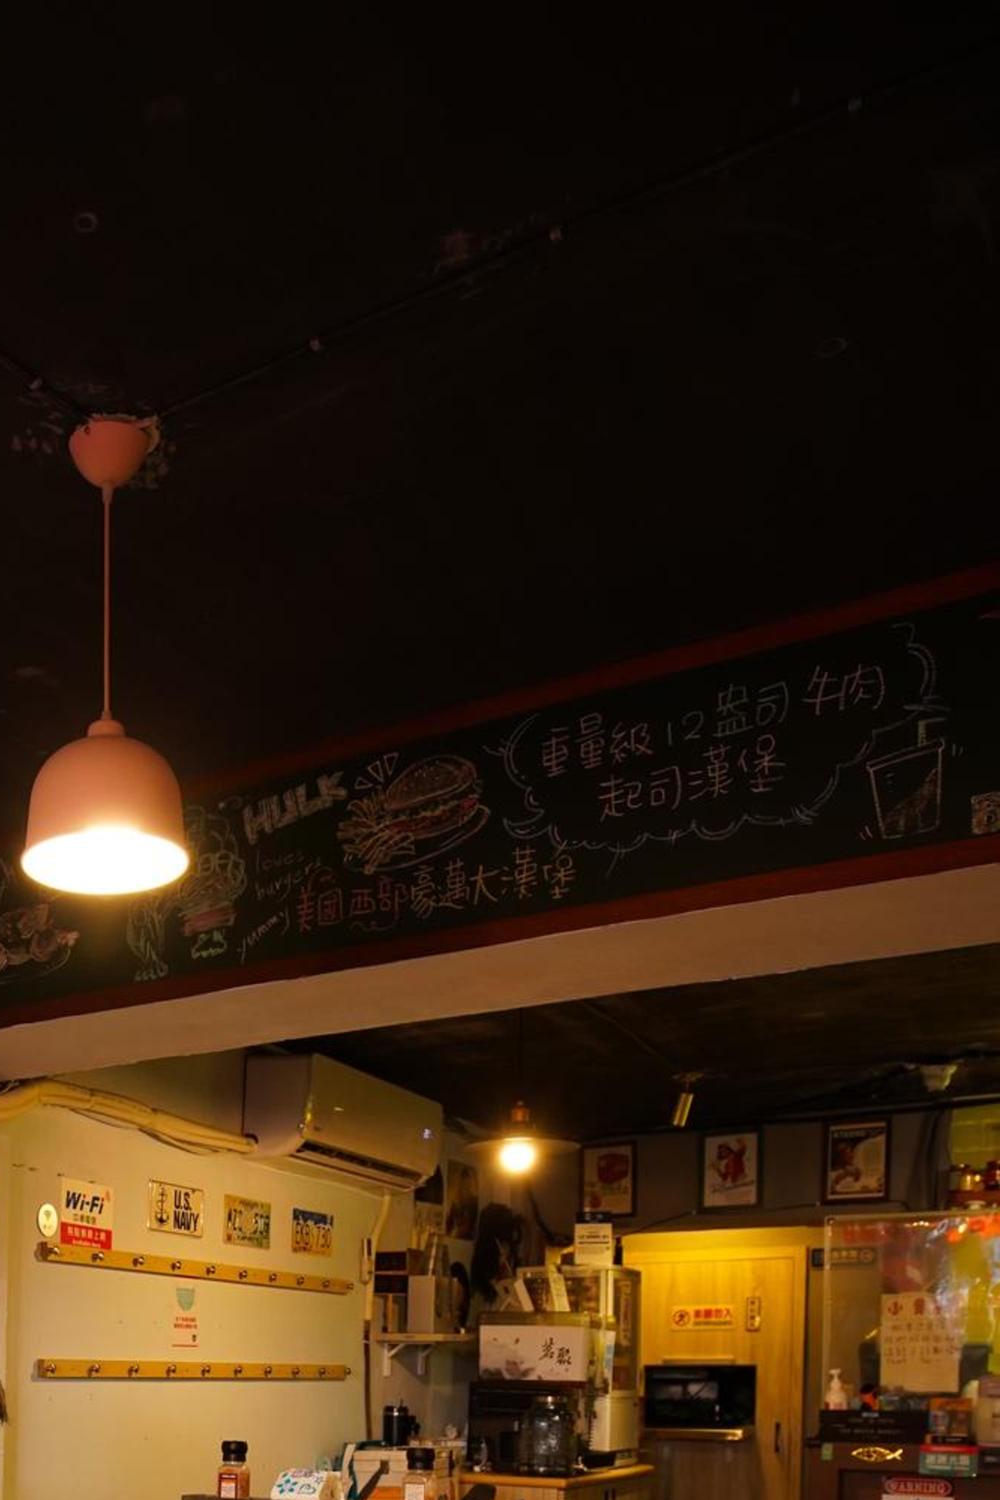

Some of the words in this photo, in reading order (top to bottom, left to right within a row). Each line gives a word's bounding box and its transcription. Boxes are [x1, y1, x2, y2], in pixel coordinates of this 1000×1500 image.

[598, 733, 786, 822] 起司漢堡
[243, 771, 348, 845] HULK
[65, 1190, 104, 1215] Wi-Fi
[173, 1189, 192, 1212] U.S.
[173, 1210, 199, 1232] NAVY
